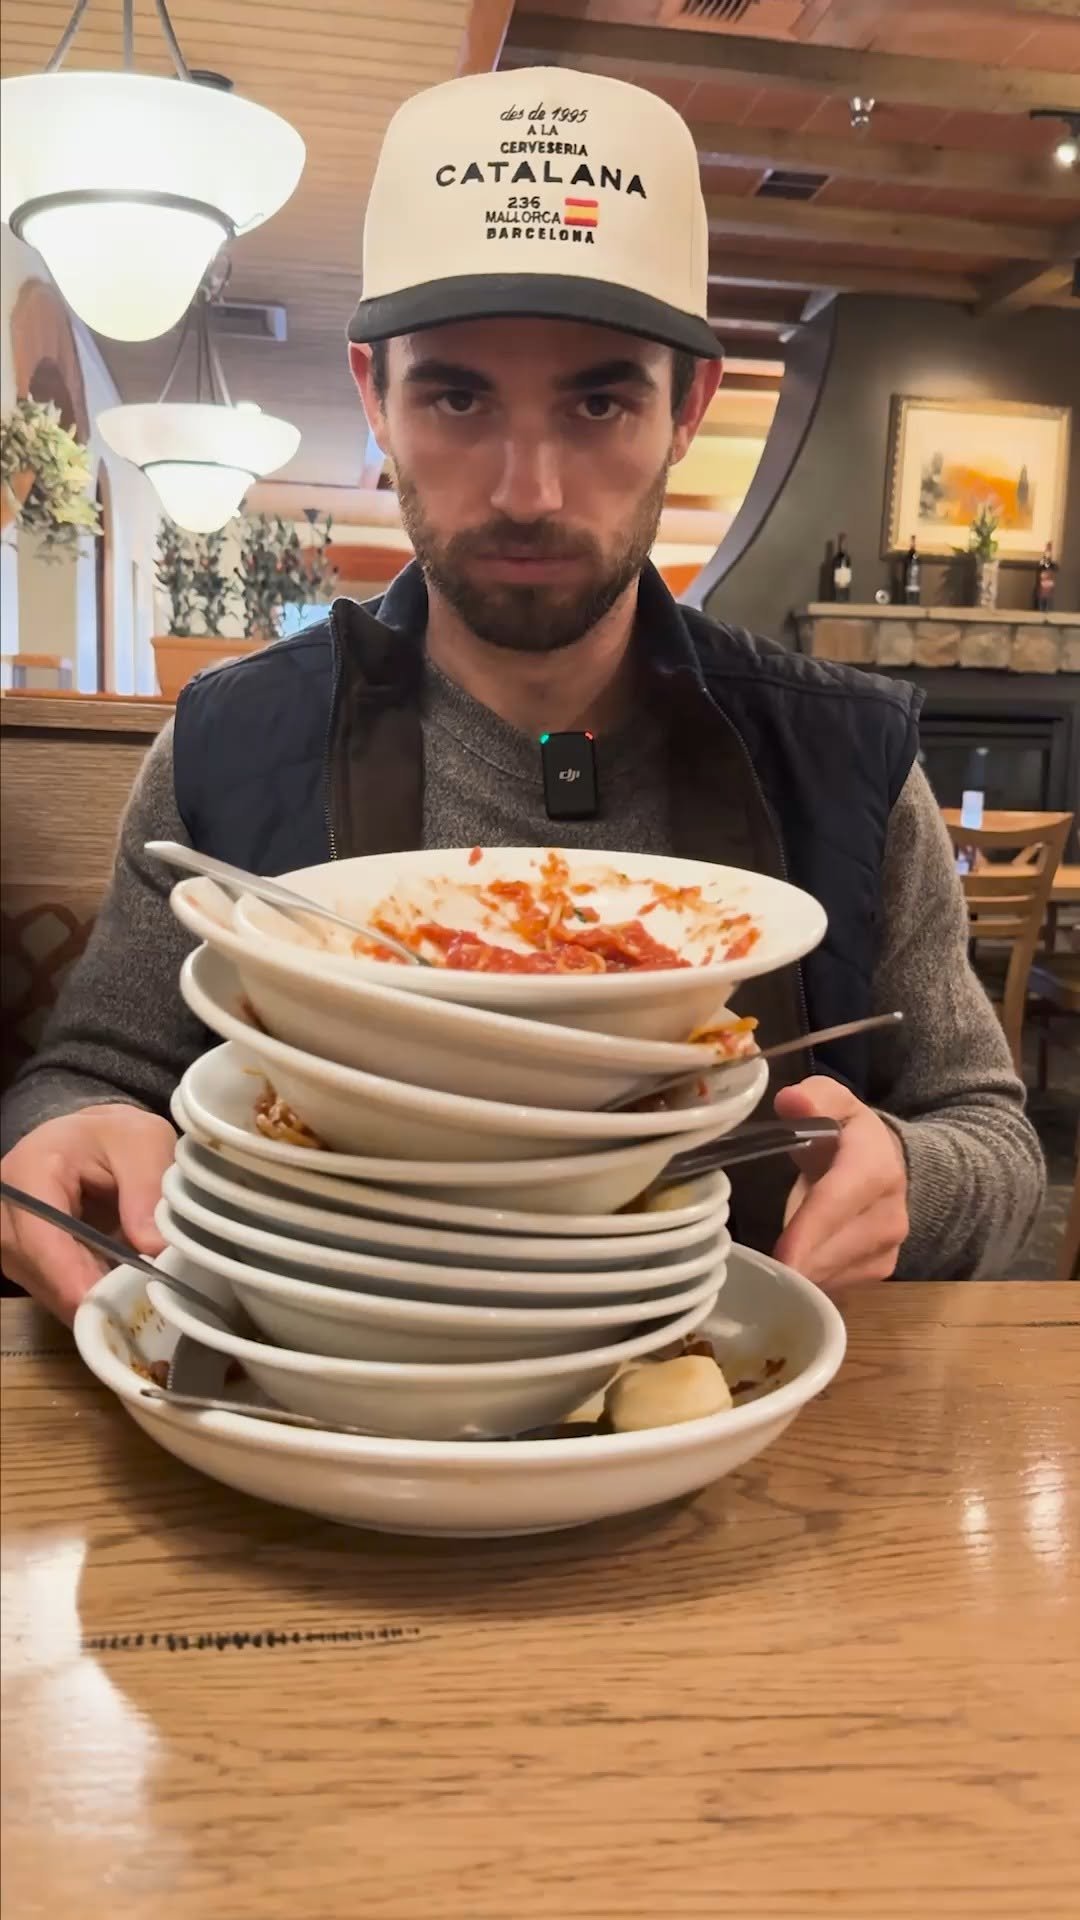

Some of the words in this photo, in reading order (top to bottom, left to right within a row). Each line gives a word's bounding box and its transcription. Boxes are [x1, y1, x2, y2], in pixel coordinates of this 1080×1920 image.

[527, 101, 545, 122] de
[550, 106, 589, 124] 1995
[526, 124, 537, 136] A
[540, 124, 559, 136] LA
[499, 140, 588, 157] CERVESERIA
[435, 160, 647, 200] CATALANA
[507, 196, 541, 209] 236
[485, 210, 561, 225] MALLORCA
[486, 227, 595, 245] BARCELONA
